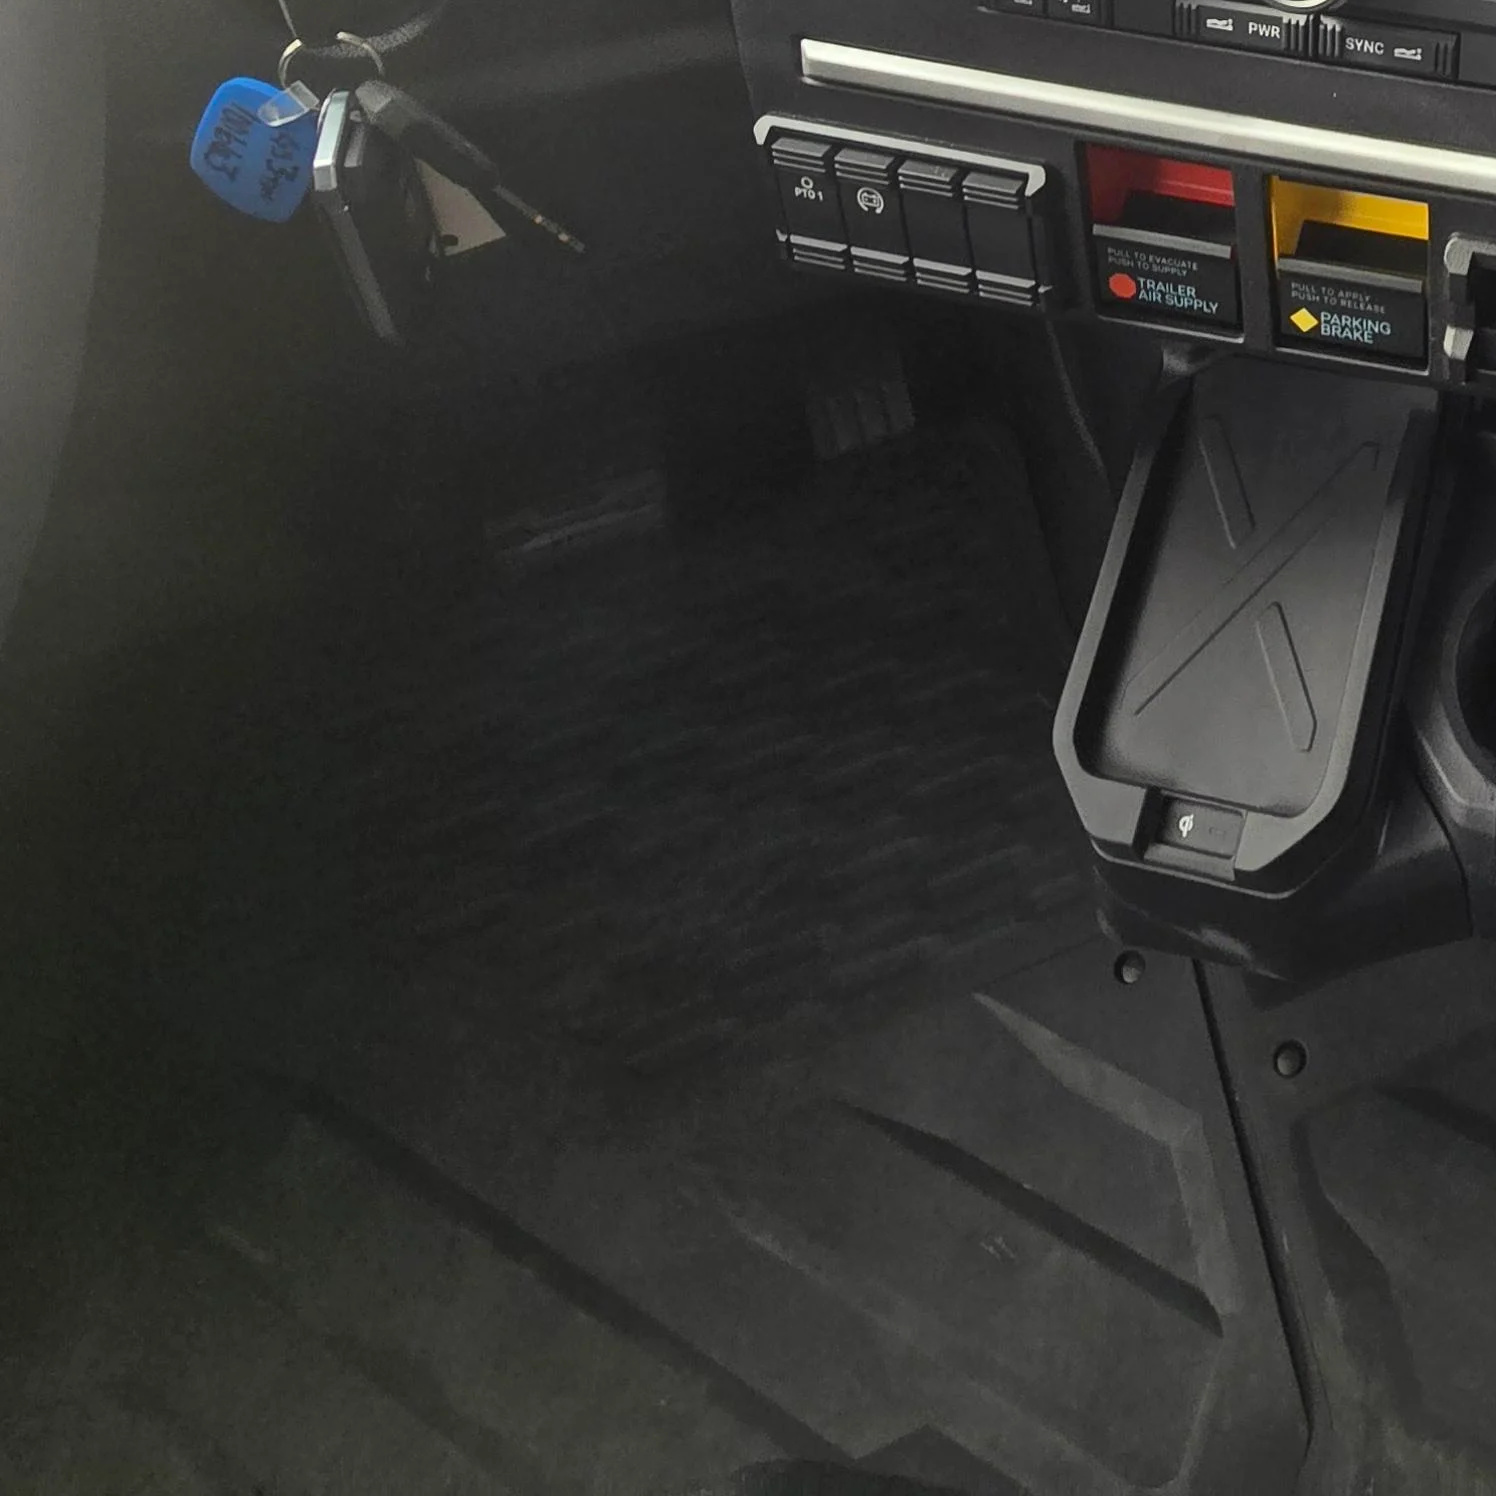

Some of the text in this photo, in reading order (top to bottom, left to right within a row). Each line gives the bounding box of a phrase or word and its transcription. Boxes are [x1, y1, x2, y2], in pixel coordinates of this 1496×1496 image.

[1248, 22, 1281, 39] PWR
[1345, 37, 1385, 55] SYNC
[794, 186, 824, 202] PTO 1
[1107, 247, 1198, 271] PULL TO EVACUATE
[1107, 255, 1188, 277] PUSH TO SUPPLY
[1137, 277, 1197, 298] TRAILER
[1291, 281, 1371, 303] PULL TO APPLY
[1138, 289, 1219, 314] AIR SUPPLY
[1291, 290, 1386, 314] PUSH TO RELEASE
[1320, 311, 1392, 336] PARKING
[1320, 323, 1374, 344] BRAKE
